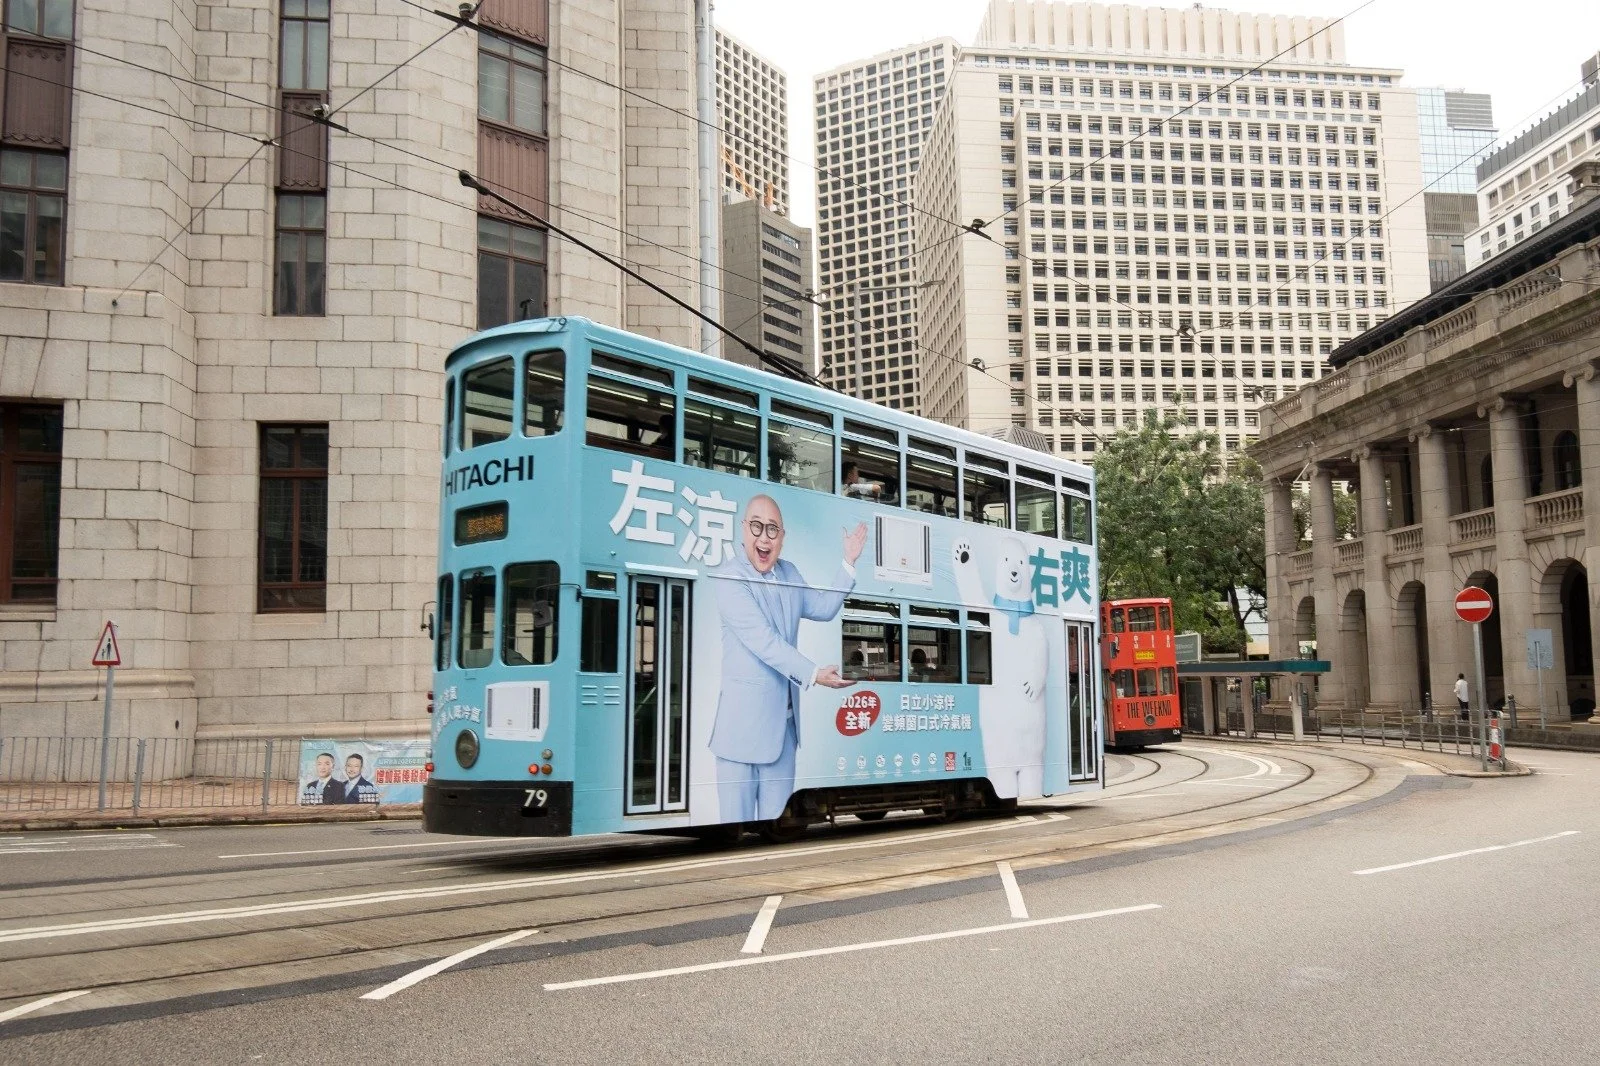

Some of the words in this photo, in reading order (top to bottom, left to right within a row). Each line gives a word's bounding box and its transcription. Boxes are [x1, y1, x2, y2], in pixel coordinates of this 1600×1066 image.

[547, 317, 567, 332] 79
[444, 455, 534, 498] HITACHI
[609, 459, 738, 567] 左涼
[1028, 546, 1092, 606] 右爽
[841, 695, 877, 709] 2026年
[900, 694, 956, 711] 日立小涼伴
[1126, 701, 1141, 719] THE
[844, 711, 871, 730] 全新
[523, 789, 548, 808] 79
